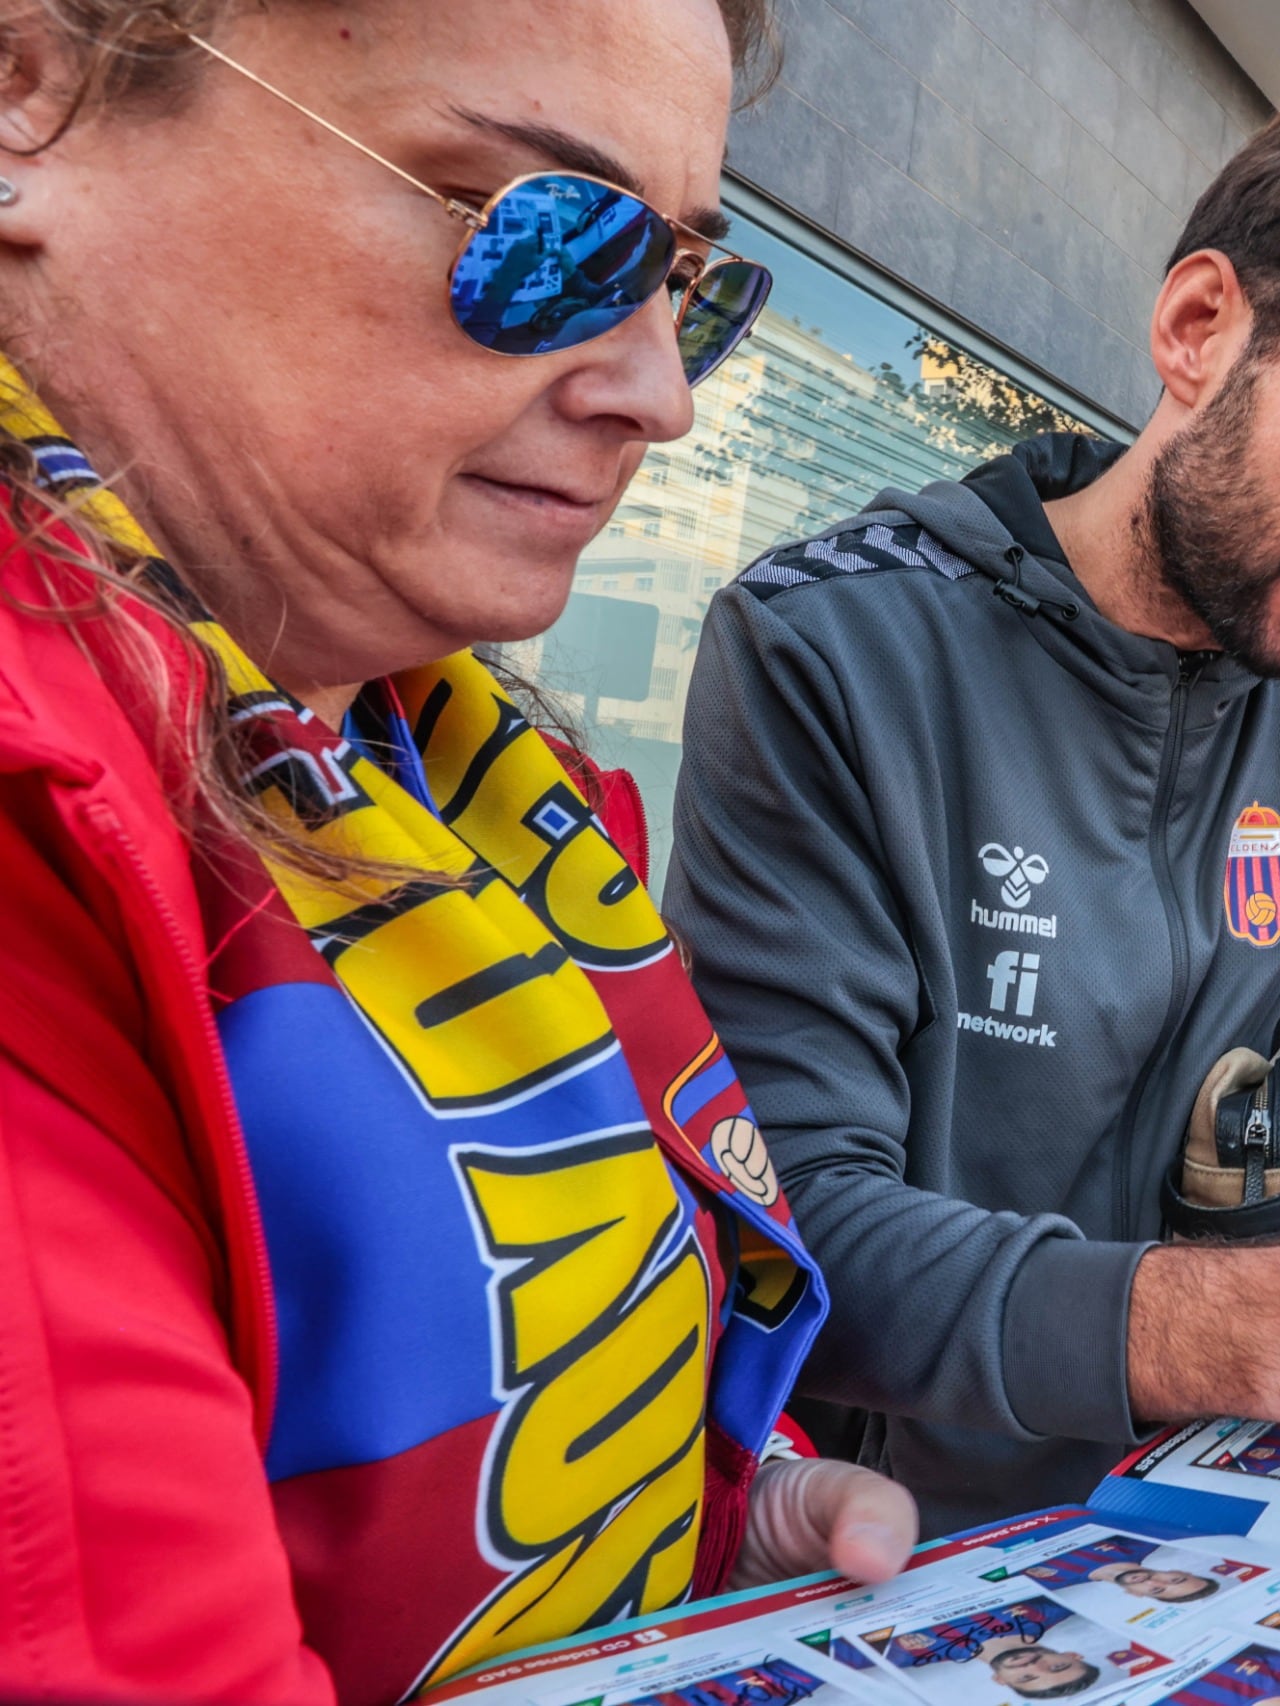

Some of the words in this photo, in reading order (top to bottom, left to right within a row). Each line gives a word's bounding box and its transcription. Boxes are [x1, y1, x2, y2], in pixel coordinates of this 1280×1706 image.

[970, 898, 1057, 939] hummel
[986, 950, 1040, 1017] fi
[957, 1011, 1058, 1048] network
[600, 1640, 632, 1652] CD
[476, 1666, 523, 1684] SAD
